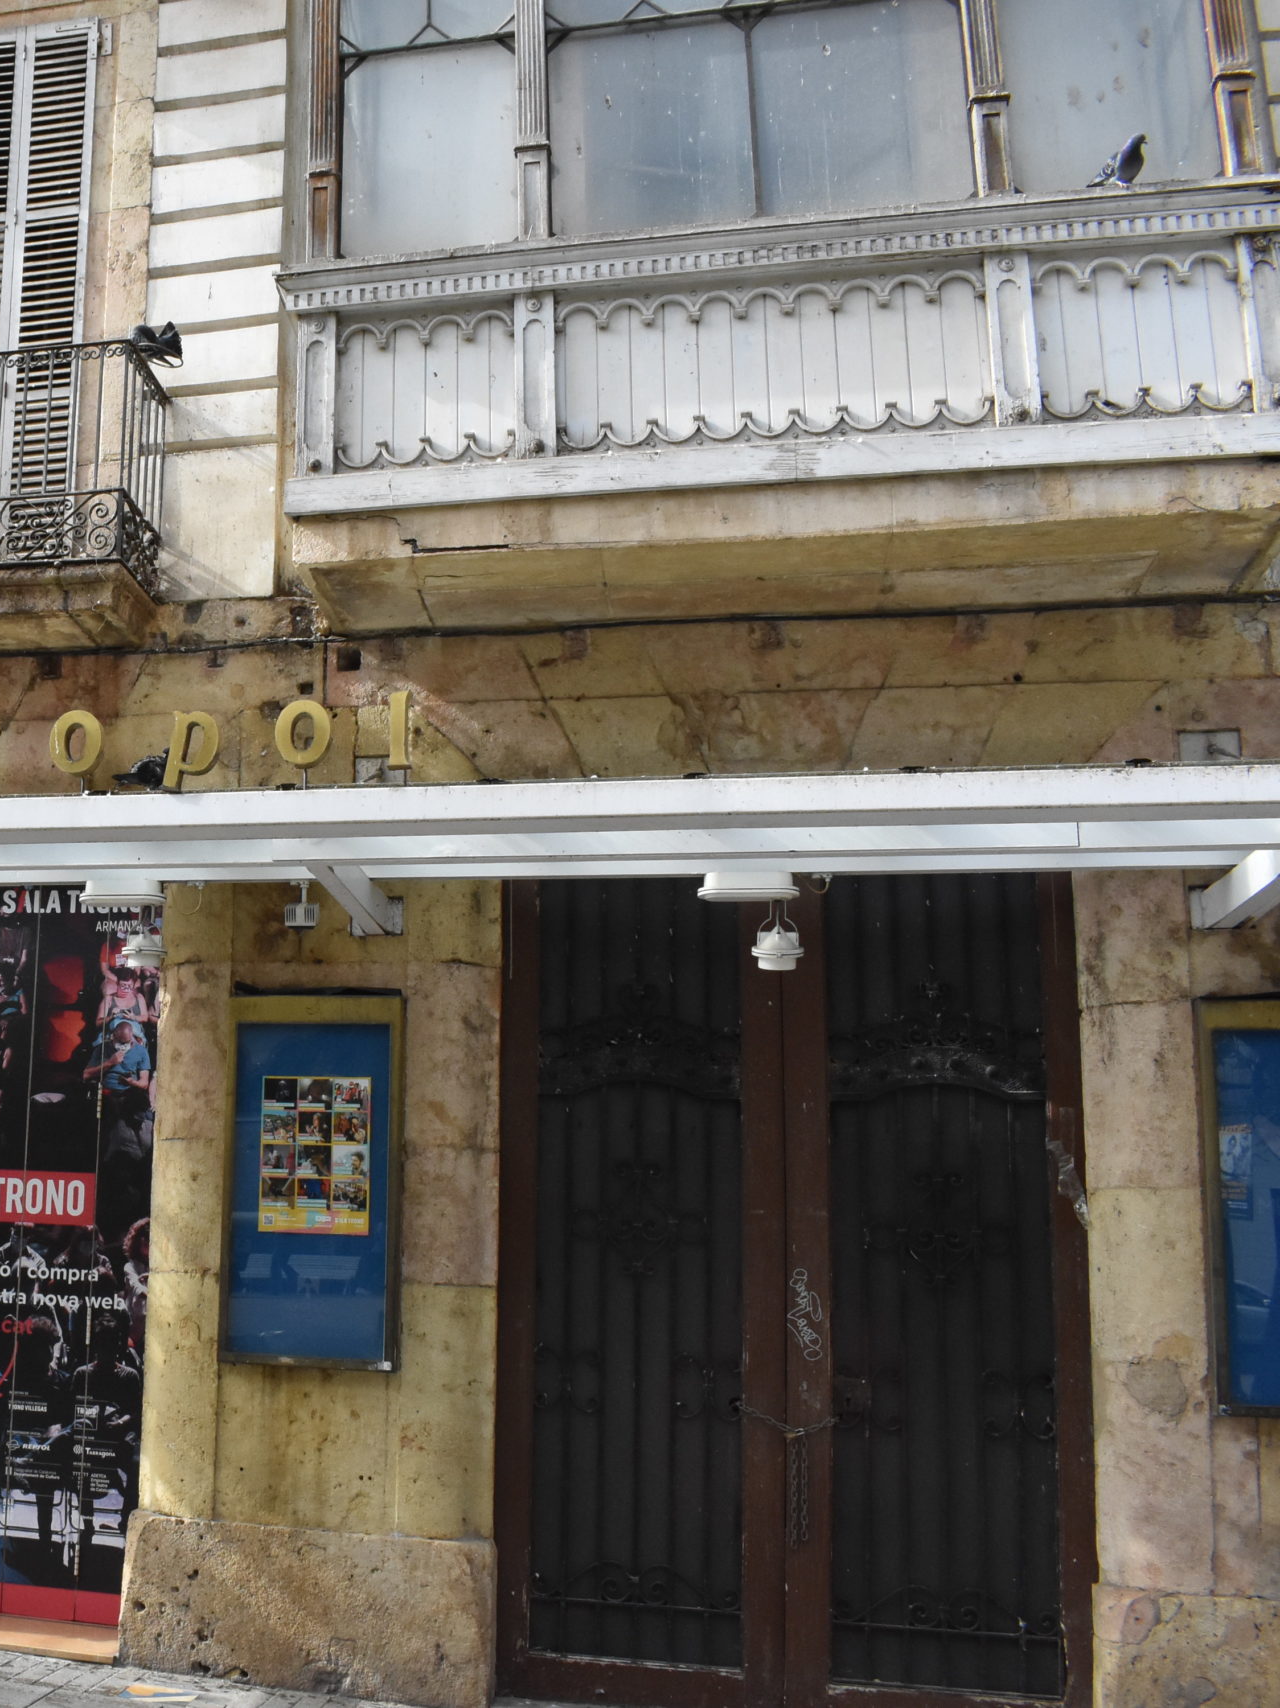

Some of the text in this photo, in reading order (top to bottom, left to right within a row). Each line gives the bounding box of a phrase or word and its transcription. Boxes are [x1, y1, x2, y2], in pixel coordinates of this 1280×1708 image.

[3, 890, 61, 914] SALA
[27, 1266, 99, 1284] compra
[32, 1294, 79, 1308] nova
[85, 1293, 126, 1310] web
[25, 1404, 48, 1412] VILLEGAS
